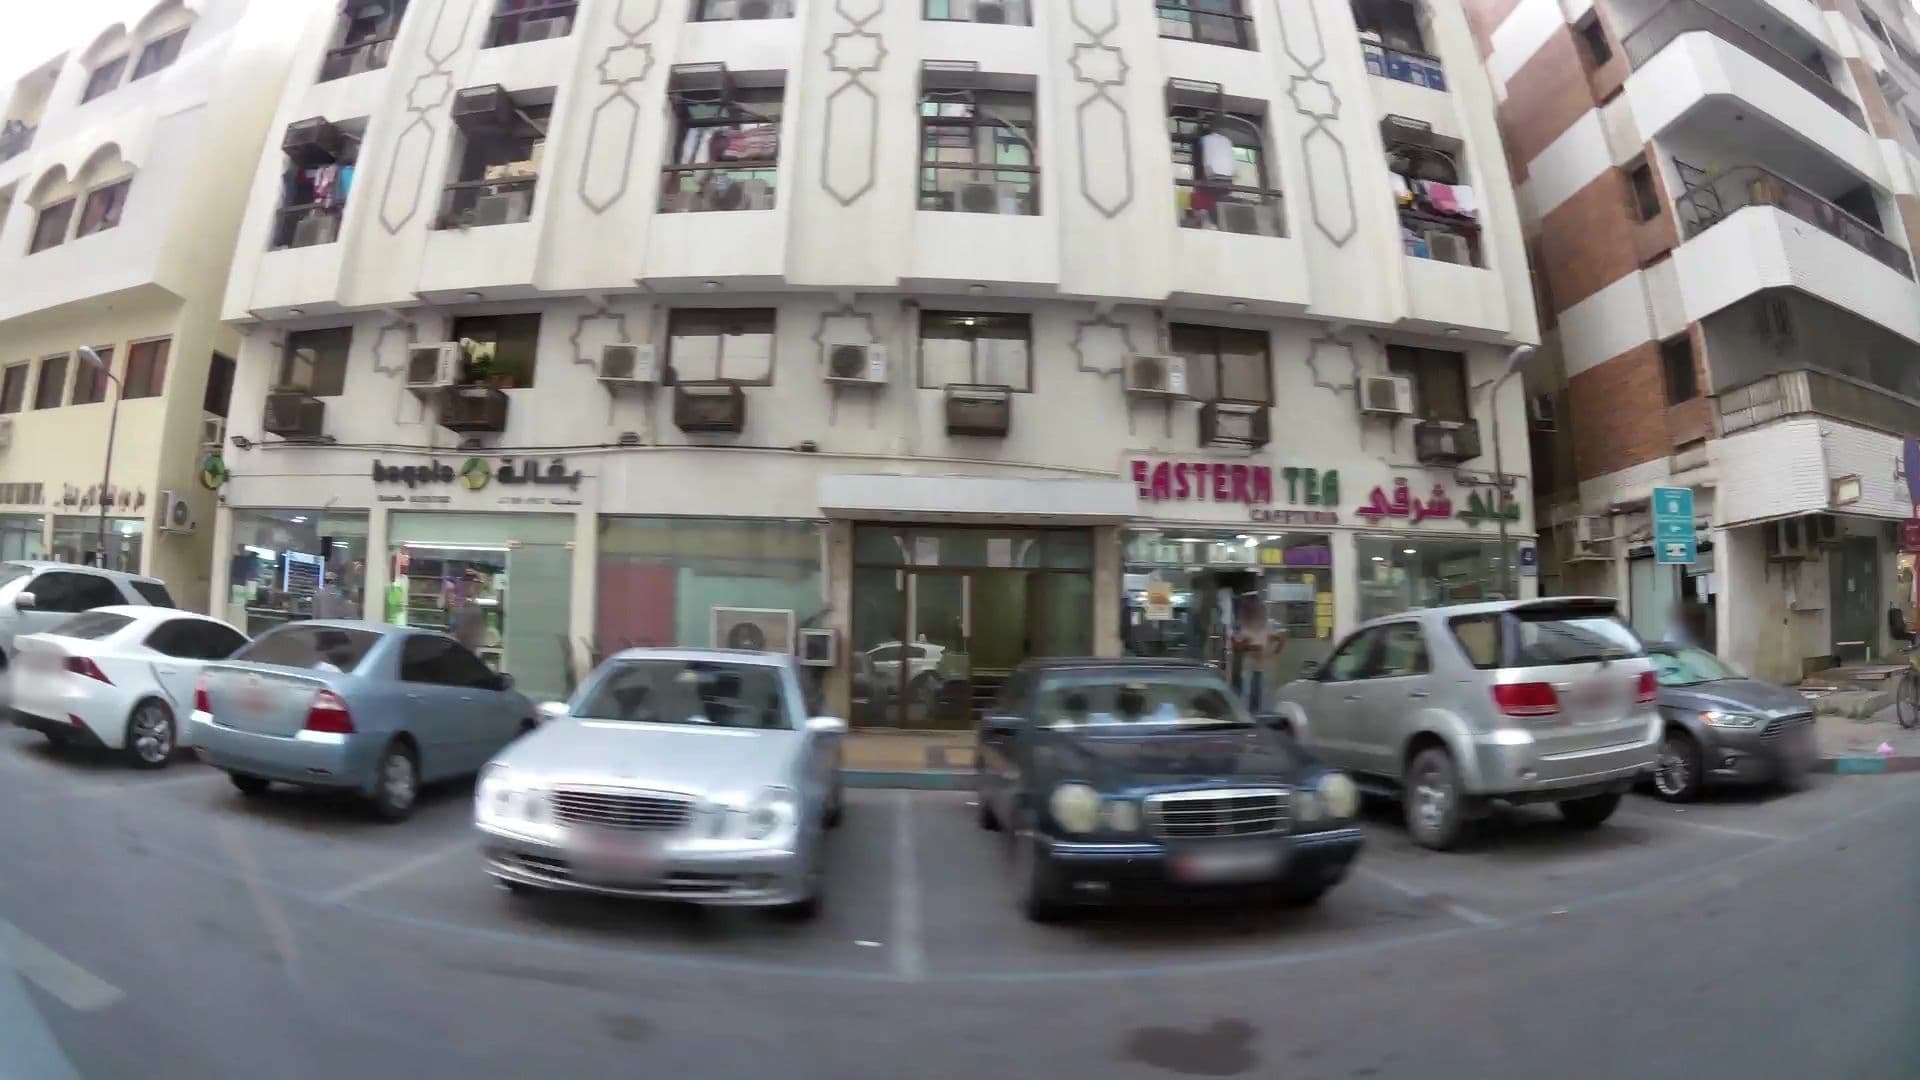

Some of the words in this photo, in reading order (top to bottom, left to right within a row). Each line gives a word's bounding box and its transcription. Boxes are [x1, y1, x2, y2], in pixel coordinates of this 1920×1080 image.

[497, 457, 582, 491] بقالة
[1131, 460, 1271, 504] EASTERN
[1282, 467, 1340, 506] TEA
[1355, 477, 1453, 526] شرقي
